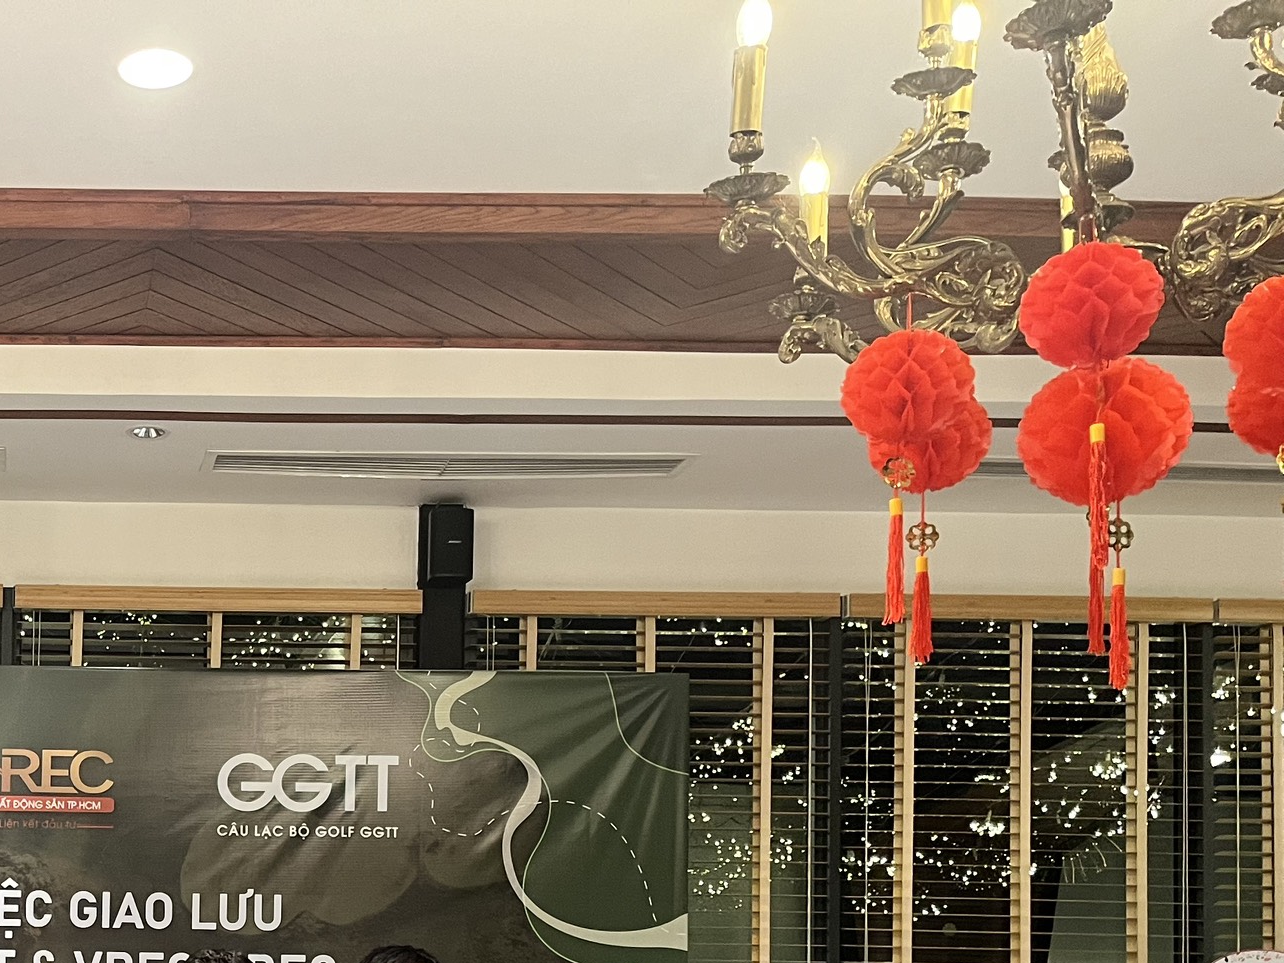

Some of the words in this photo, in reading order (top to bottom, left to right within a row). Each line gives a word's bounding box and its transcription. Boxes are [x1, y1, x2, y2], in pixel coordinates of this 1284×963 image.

[217, 753, 400, 812] GGTT
[13, 798, 43, 811] ĐỘNG
[46, 797, 65, 809] SẢN
[67, 800, 101, 810] TP.HCM
[216, 822, 249, 837] CÂU
[254, 825, 284, 840] LẠC
[289, 823, 310, 840] BỘ
[315, 825, 355, 839] GOLF
[359, 826, 399, 839] GGTT
[69, 890, 174, 931] GIAO
[191, 888, 283, 931] LƯU
